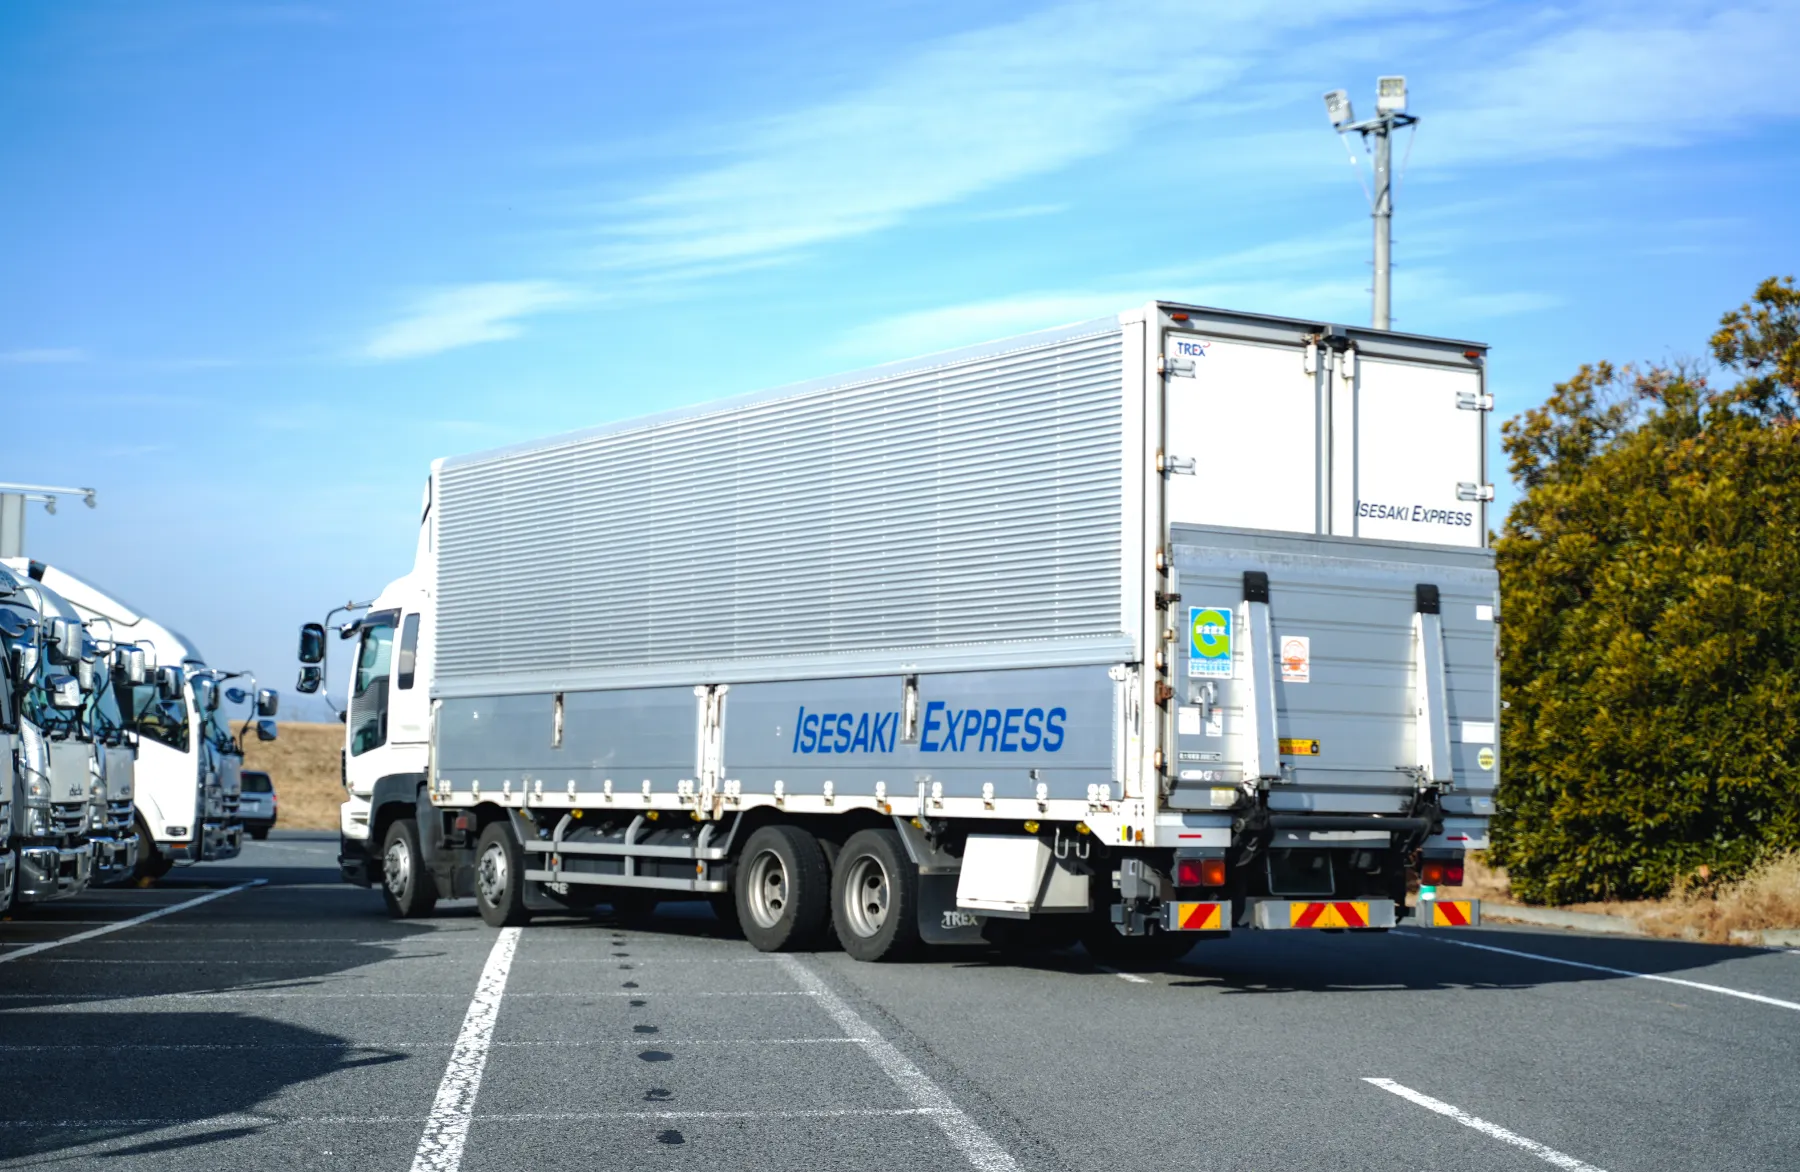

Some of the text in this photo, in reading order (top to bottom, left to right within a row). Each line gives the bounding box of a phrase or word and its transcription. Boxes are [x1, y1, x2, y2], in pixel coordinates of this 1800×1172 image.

[1177, 342, 1206, 357] TREX
[1355, 500, 1473, 527] ISESAKI EXPRESS
[792, 701, 1067, 753] ISESAKI EXPRESS
[943, 911, 978, 926] TREX
